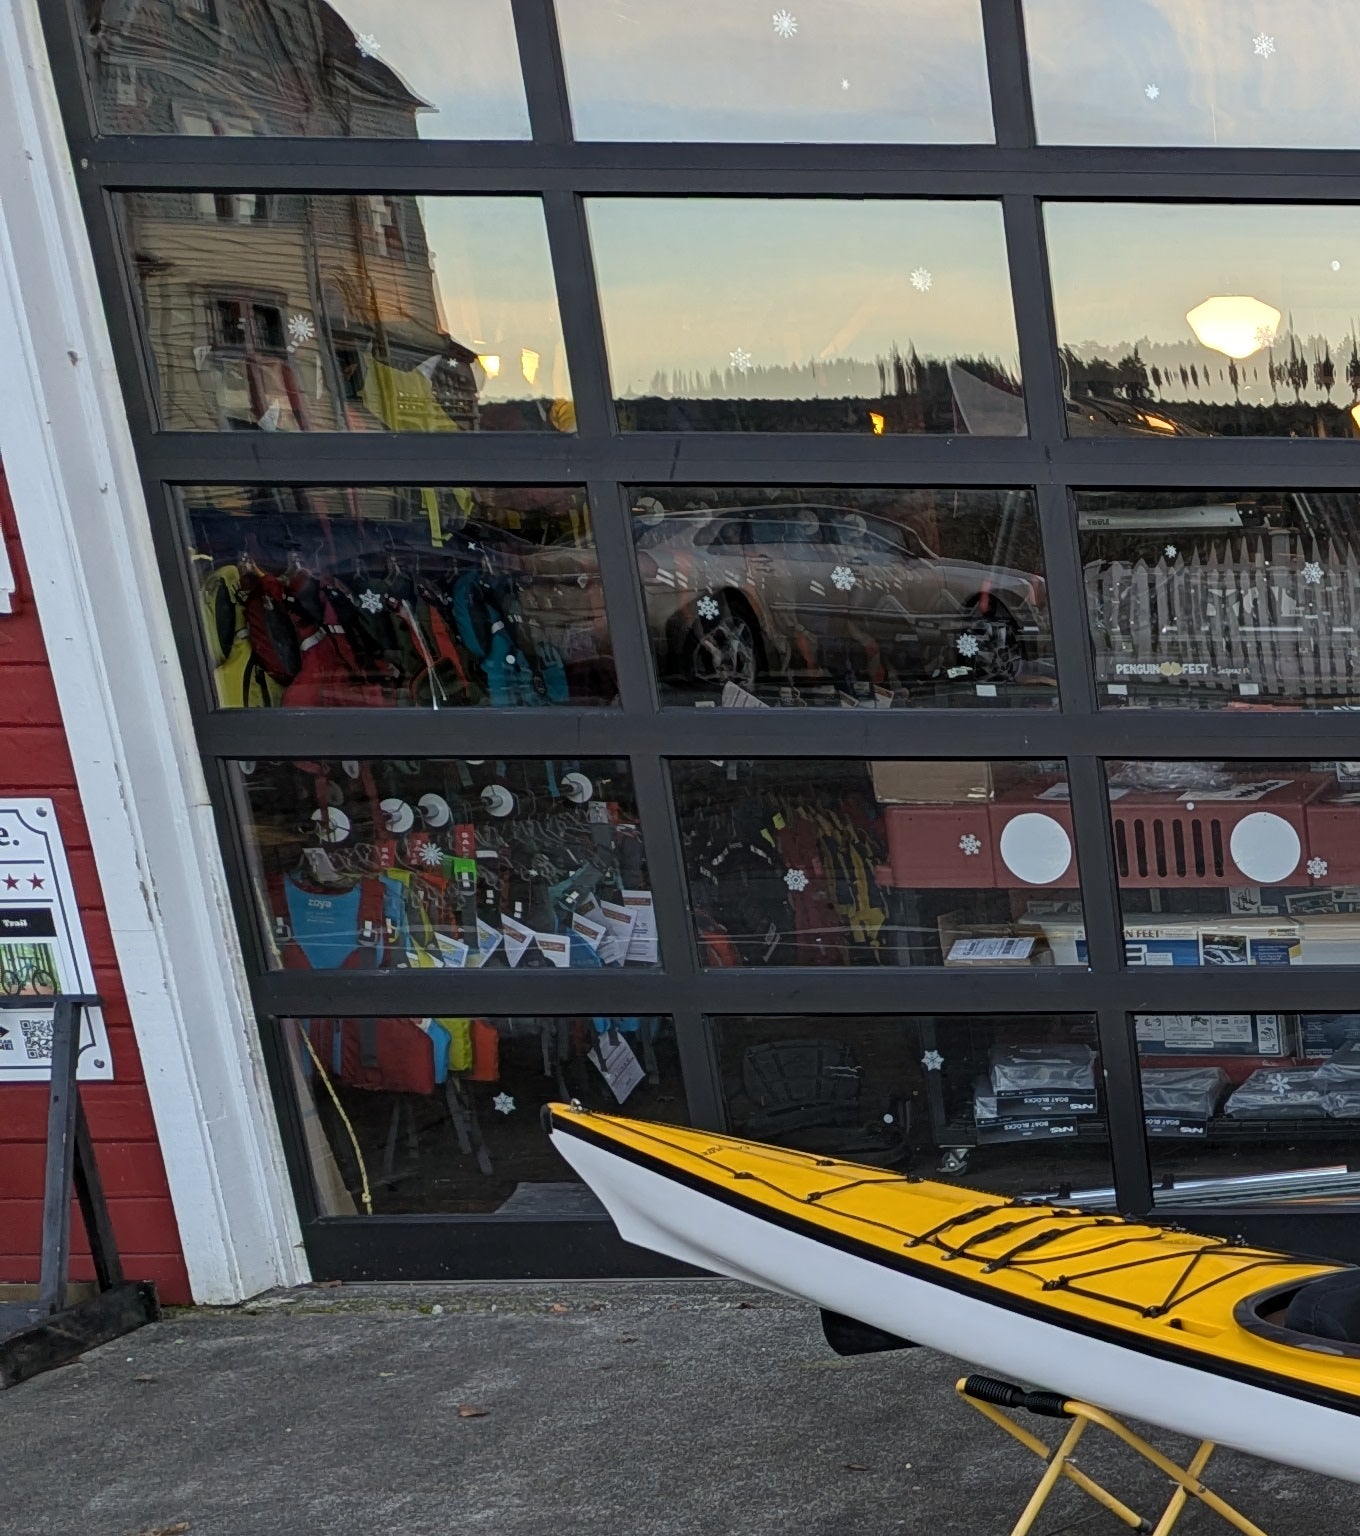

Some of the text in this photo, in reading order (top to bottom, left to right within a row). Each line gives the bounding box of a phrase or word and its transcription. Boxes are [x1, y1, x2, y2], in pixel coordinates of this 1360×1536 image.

[1116, 663, 1160, 675] PENGUIN
[1182, 663, 1209, 674] FEET
[308, 898, 332, 910] zoya
[2, 919, 28, 928] Trail
[1050, 1125, 1074, 1134] NRS
[1180, 1126, 1204, 1134] NRS
